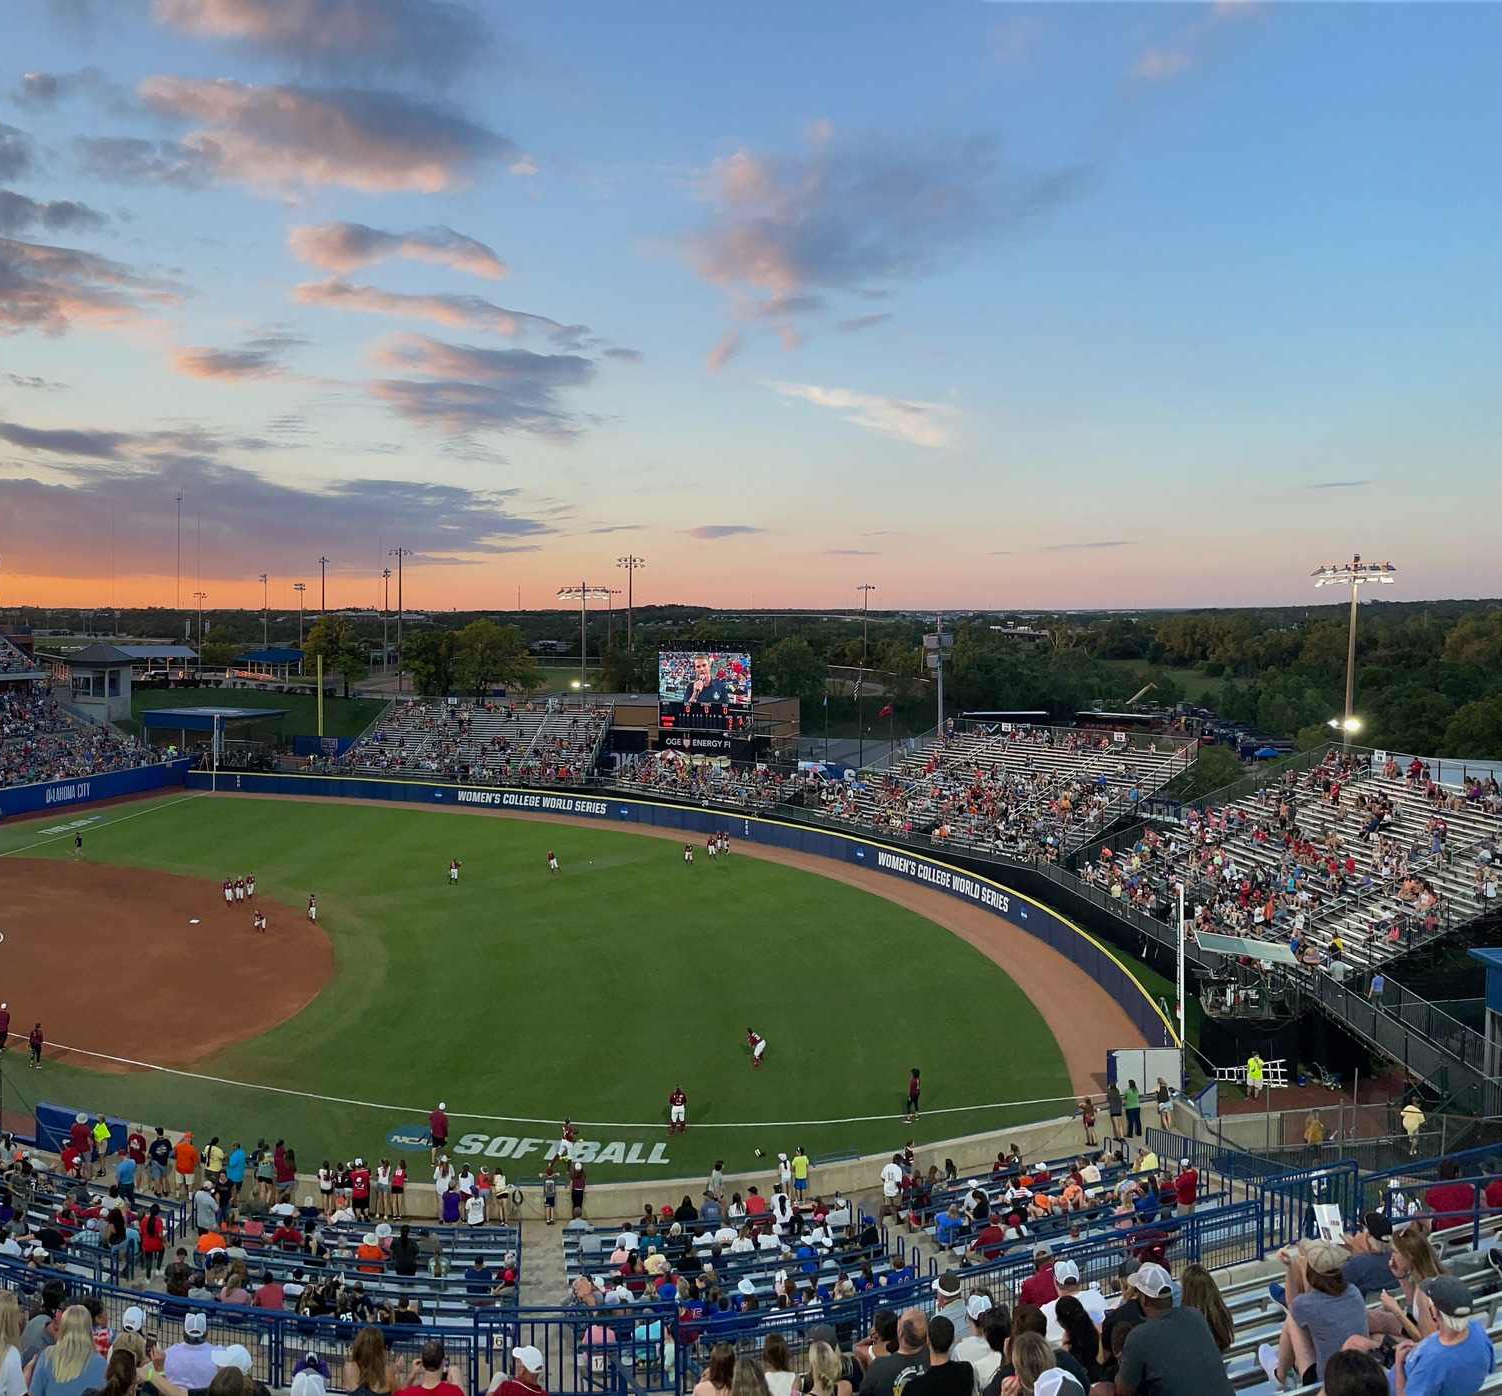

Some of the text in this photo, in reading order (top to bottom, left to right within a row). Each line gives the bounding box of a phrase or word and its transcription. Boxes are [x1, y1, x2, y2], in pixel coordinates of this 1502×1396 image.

[692, 740, 723, 748] ENERGY
[78, 782, 90, 798] CITY
[458, 790, 607, 814] WOMEN'S COLLEGE WORLD SERIES
[878, 851, 1009, 913] WOMEN'S COLLEGE WORLD SERIES
[453, 1134, 670, 1164] SOFTBALL
[340, 1312, 353, 1322] 25
